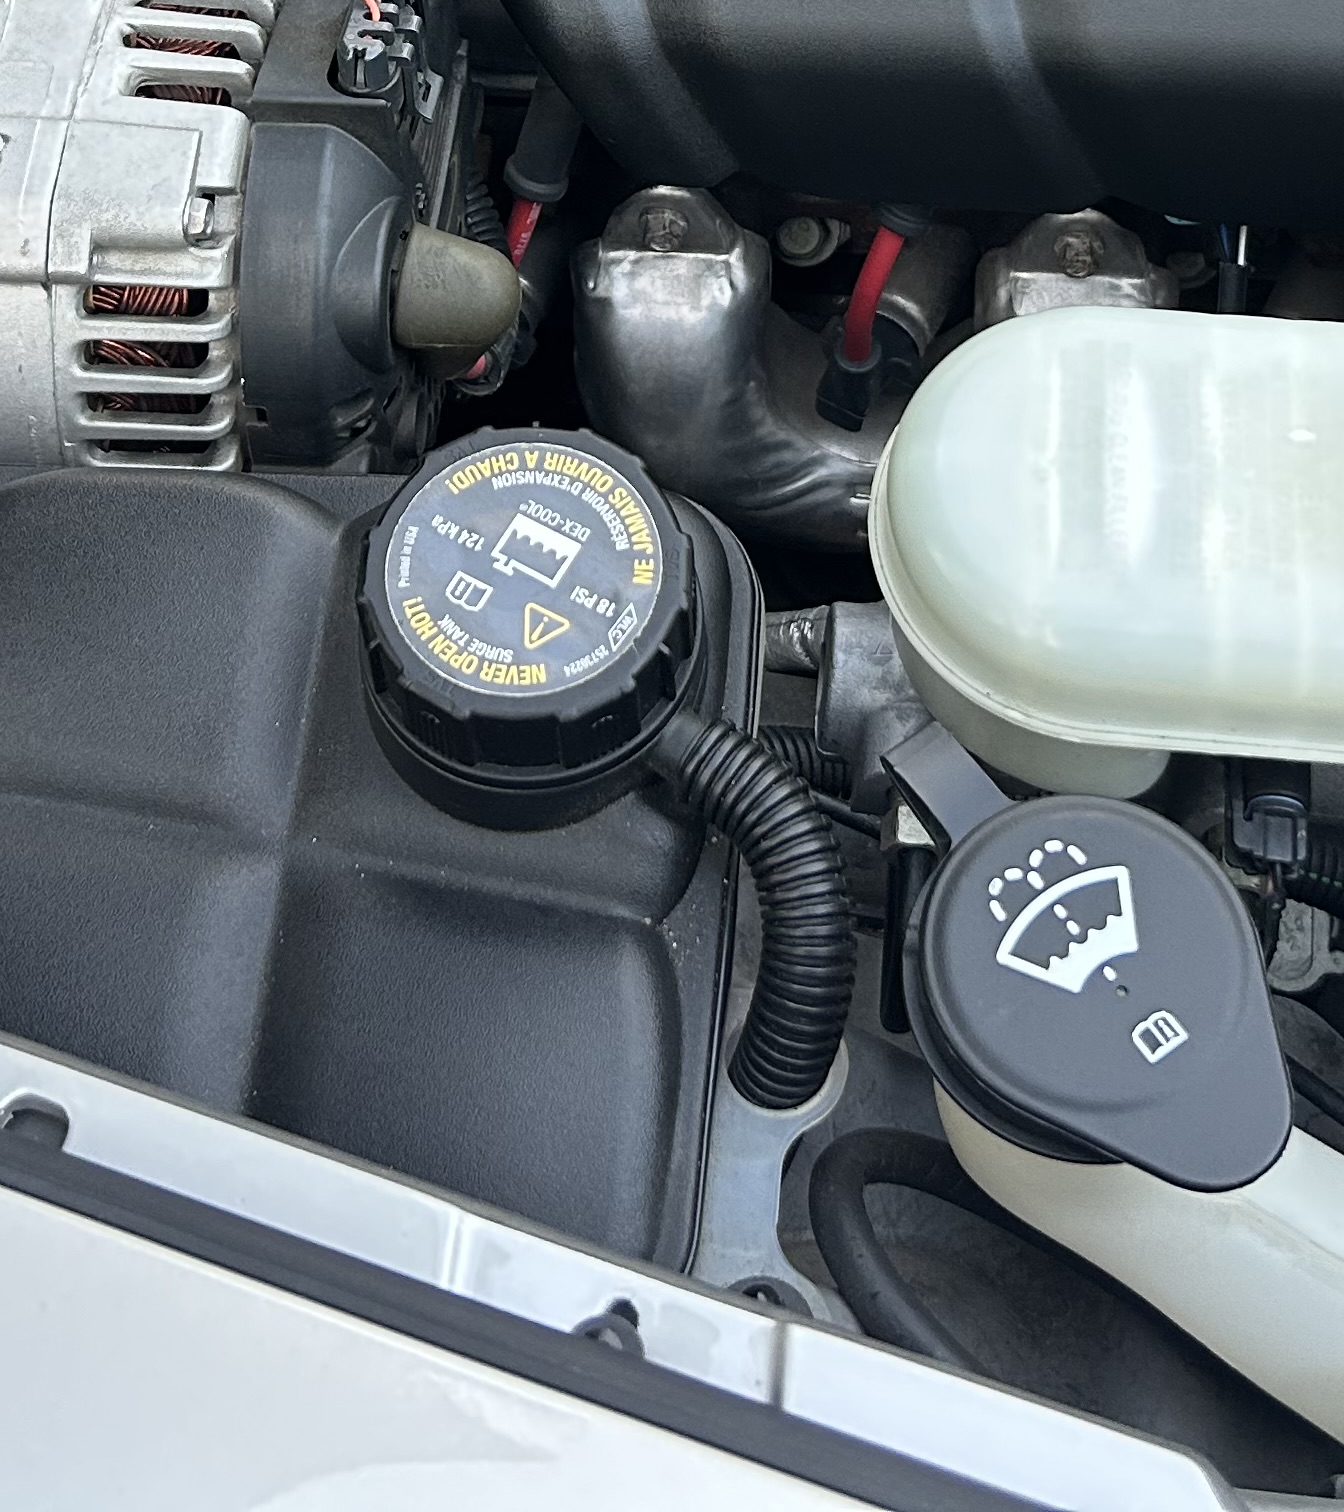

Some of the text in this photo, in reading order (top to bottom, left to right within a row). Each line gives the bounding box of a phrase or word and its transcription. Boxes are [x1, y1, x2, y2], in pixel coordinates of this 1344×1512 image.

[444, 451, 520, 495] CHAUD!
[491, 469, 584, 496] D'EXPANSION
[543, 451, 614, 493] OUVRIR
[403, 525, 420, 545] USA
[431, 514, 485, 552] 124 kPa
[607, 487, 654, 555] JAMAIS
[632, 557, 655, 585] NE
[402, 596, 439, 642] HOT!
[569, 585, 616, 618] 18 PSI
[427, 633, 479, 675] OPEN
[437, 613, 514, 664] SURGE TANK
[479, 660, 547, 686] NEVER
